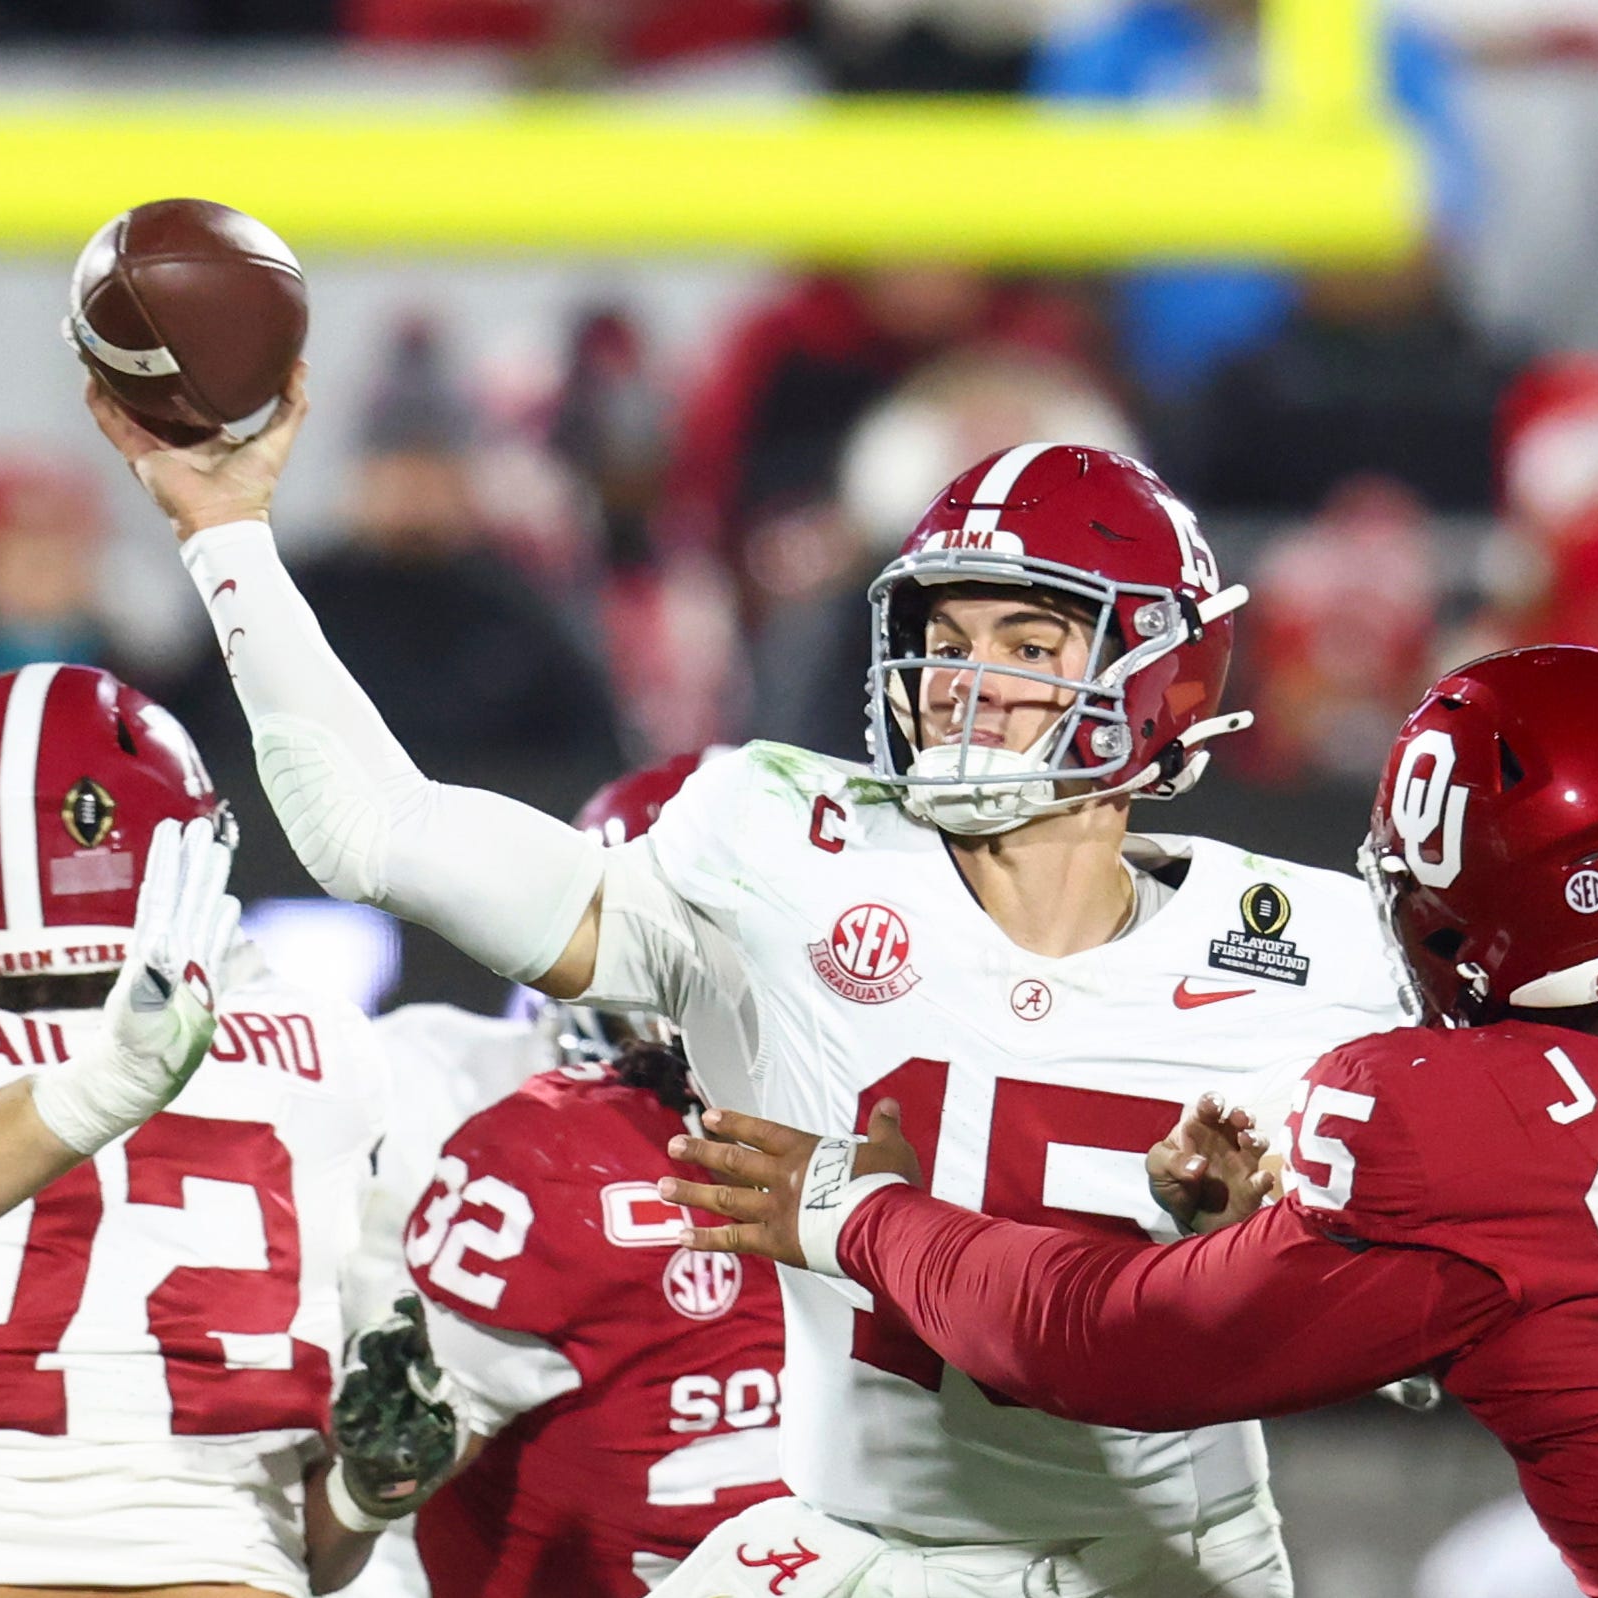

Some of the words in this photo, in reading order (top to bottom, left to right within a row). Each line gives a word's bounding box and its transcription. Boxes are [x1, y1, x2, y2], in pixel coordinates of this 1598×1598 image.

[810, 794, 847, 854] C
[1391, 730, 1469, 888] OU
[834, 906, 907, 978] SEC
[1211, 942, 1256, 960] FIRST
[1257, 953, 1307, 971] ROUND
[1229, 933, 1294, 955] PLAYOFF
[817, 959, 900, 1001] GRADUATE
[404, 1154, 535, 1311] 32
[669, 1250, 736, 1313] SEC
